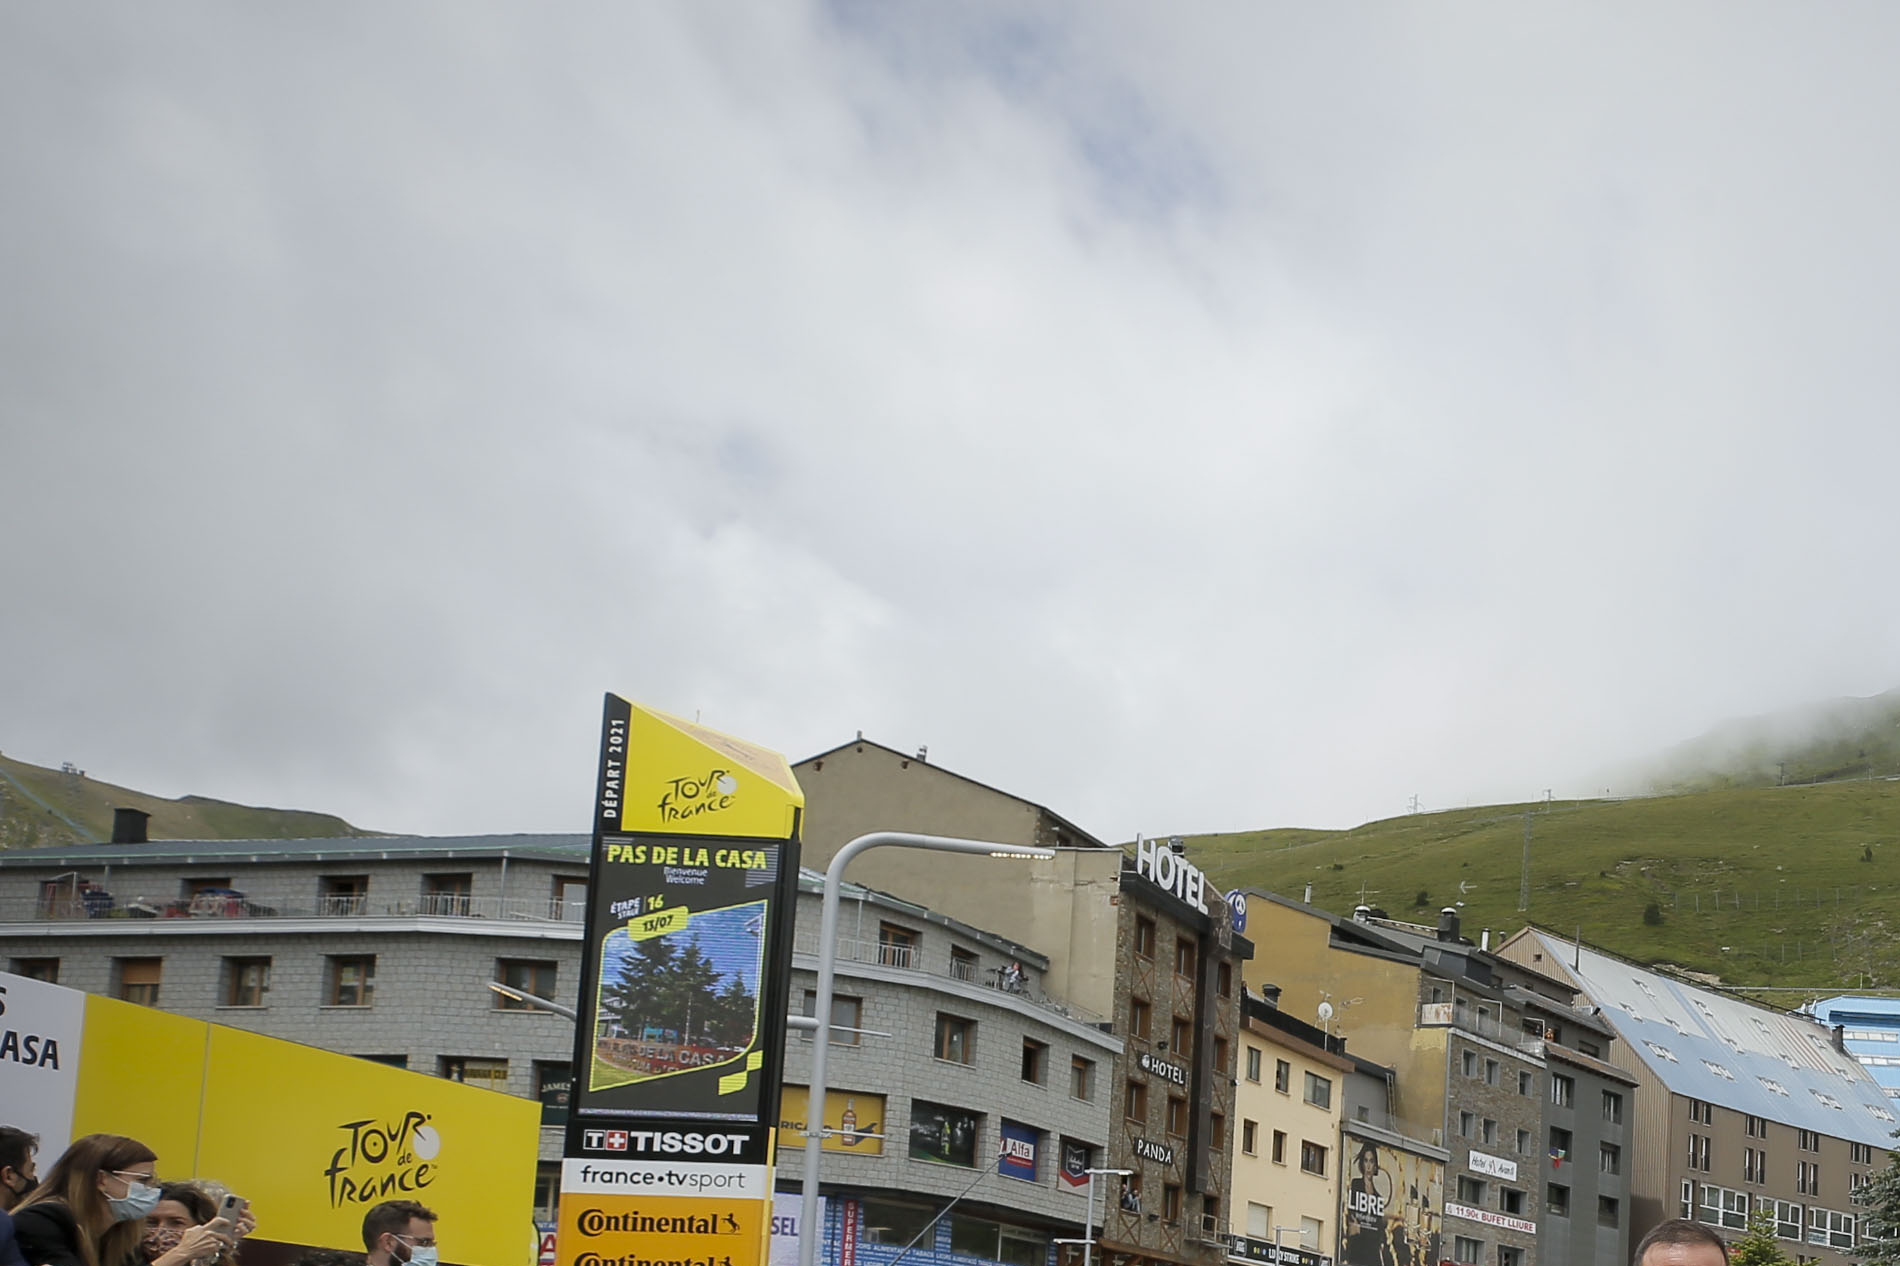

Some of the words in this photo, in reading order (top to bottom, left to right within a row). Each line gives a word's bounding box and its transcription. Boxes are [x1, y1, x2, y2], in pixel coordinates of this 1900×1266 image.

[609, 718, 625, 752] 2021
[603, 759, 621, 818] DÉPART
[665, 769, 731, 801] TOUR
[606, 845, 647, 865] PAS
[651, 846, 678, 866] DE
[682, 847, 709, 867] LA
[714, 849, 768, 870] CASA
[663, 866, 708, 878] Bienvenue
[665, 875, 706, 886] Welcome
[1136, 833, 1209, 915] HOTEL
[610, 897, 641, 914] ÉTAPE
[647, 894, 664, 911] 16
[1151, 1057, 1185, 1085] HOTEL
[338, 1110, 433, 1165] TOUR
[630, 1131, 750, 1155] TISSOT
[1137, 1139, 1172, 1164] PANDA
[1348, 1190, 1385, 1217] LIBRE
[577, 1208, 719, 1237] Continental
[1481, 1212, 1506, 1225] BUFET
[1507, 1219, 1534, 1231] LLIURE
